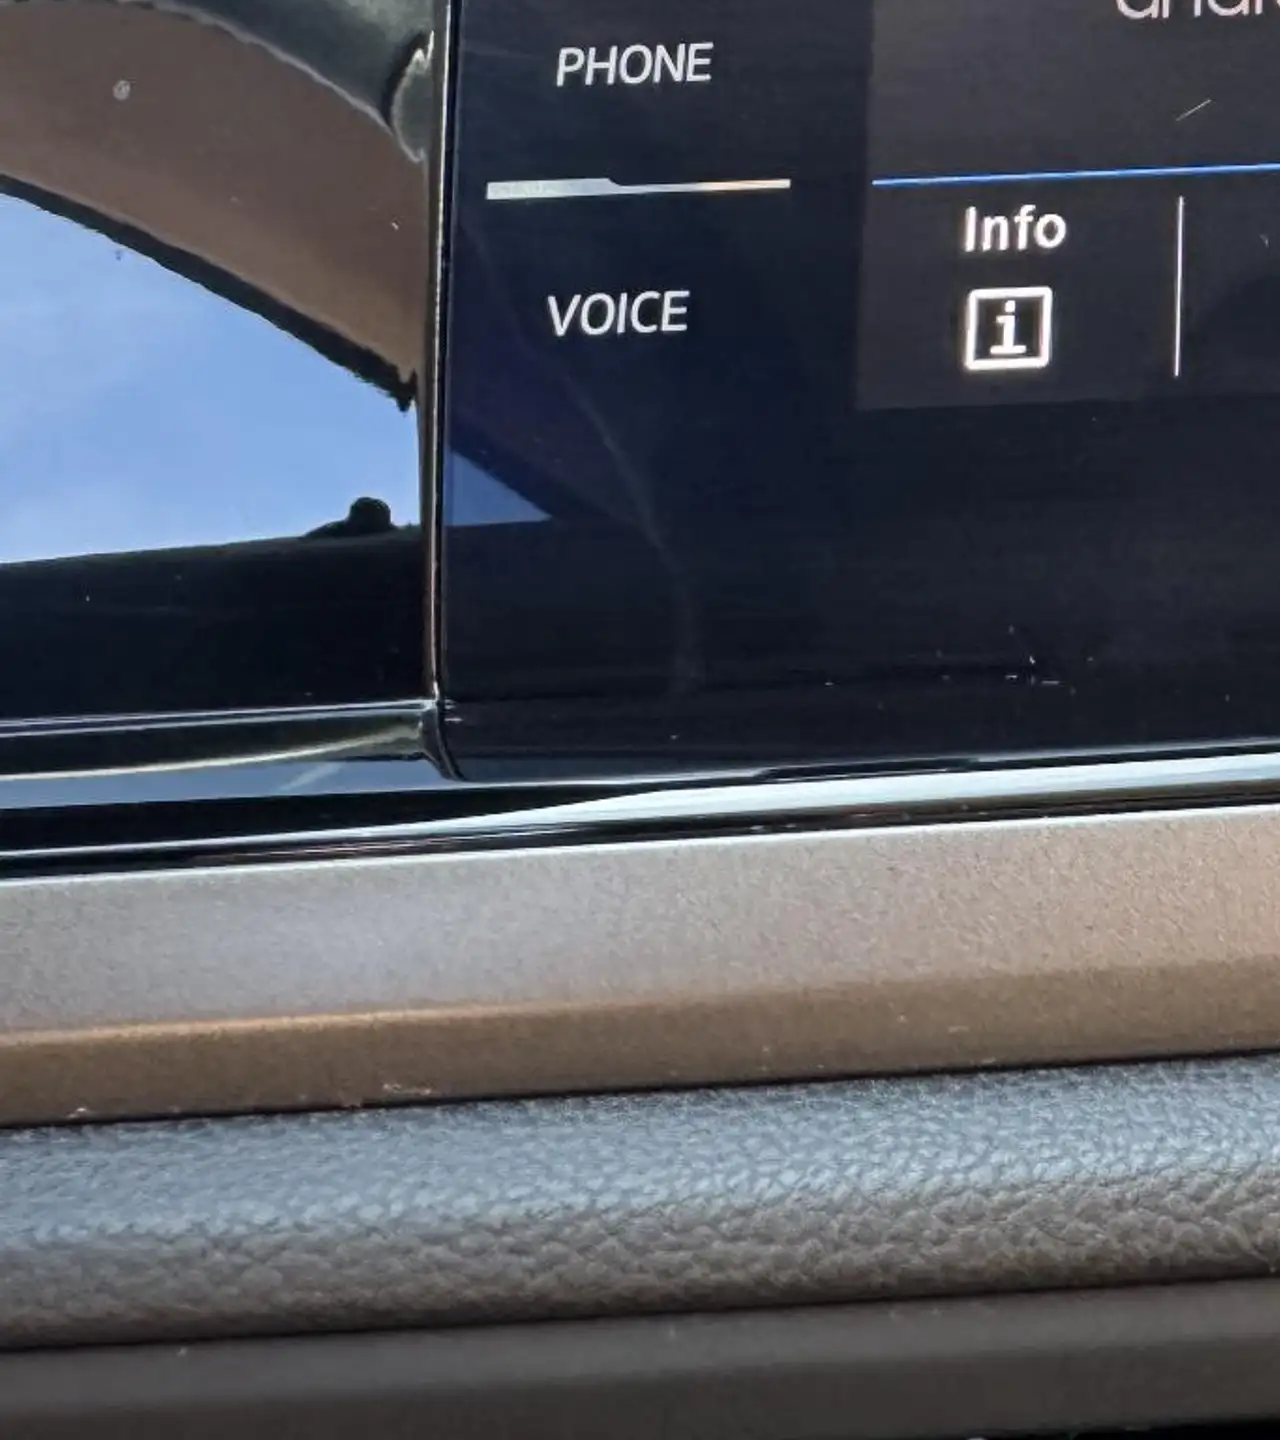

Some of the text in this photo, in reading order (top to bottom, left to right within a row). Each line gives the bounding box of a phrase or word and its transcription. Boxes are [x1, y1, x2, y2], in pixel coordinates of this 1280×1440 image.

[556, 42, 714, 87] PHONE
[963, 204, 1067, 253] Info
[547, 290, 690, 337] VOICE
